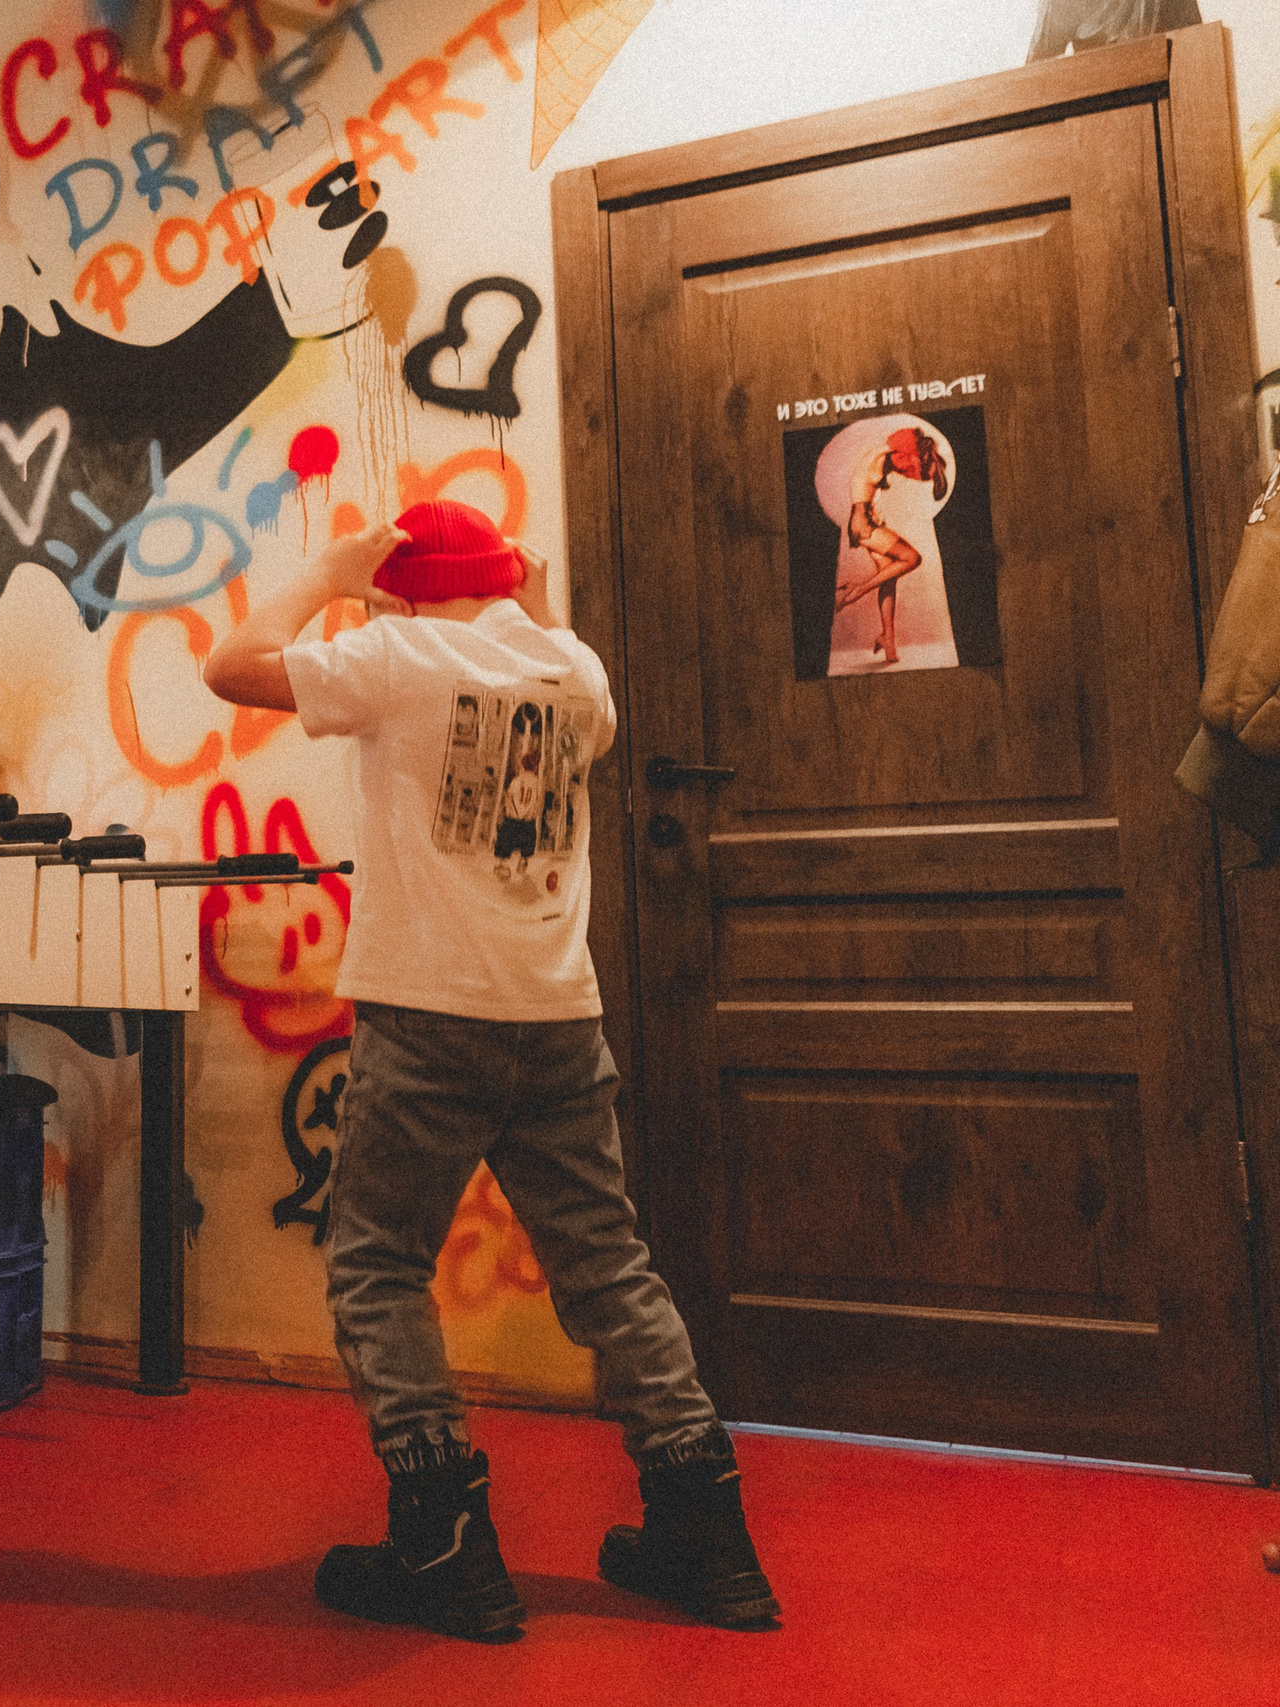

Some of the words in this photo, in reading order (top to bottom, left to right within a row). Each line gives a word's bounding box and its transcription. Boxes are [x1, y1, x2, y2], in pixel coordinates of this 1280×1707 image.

[45, 0, 384, 253] DRAFT
[72, 186, 277, 332] POP
[286, 0, 524, 210] ART
[776, 402, 790, 421] И
[794, 397, 829, 419] ЭТО
[832, 389, 878, 413] ТОЖЕ
[881, 385, 904, 406] НЕ
